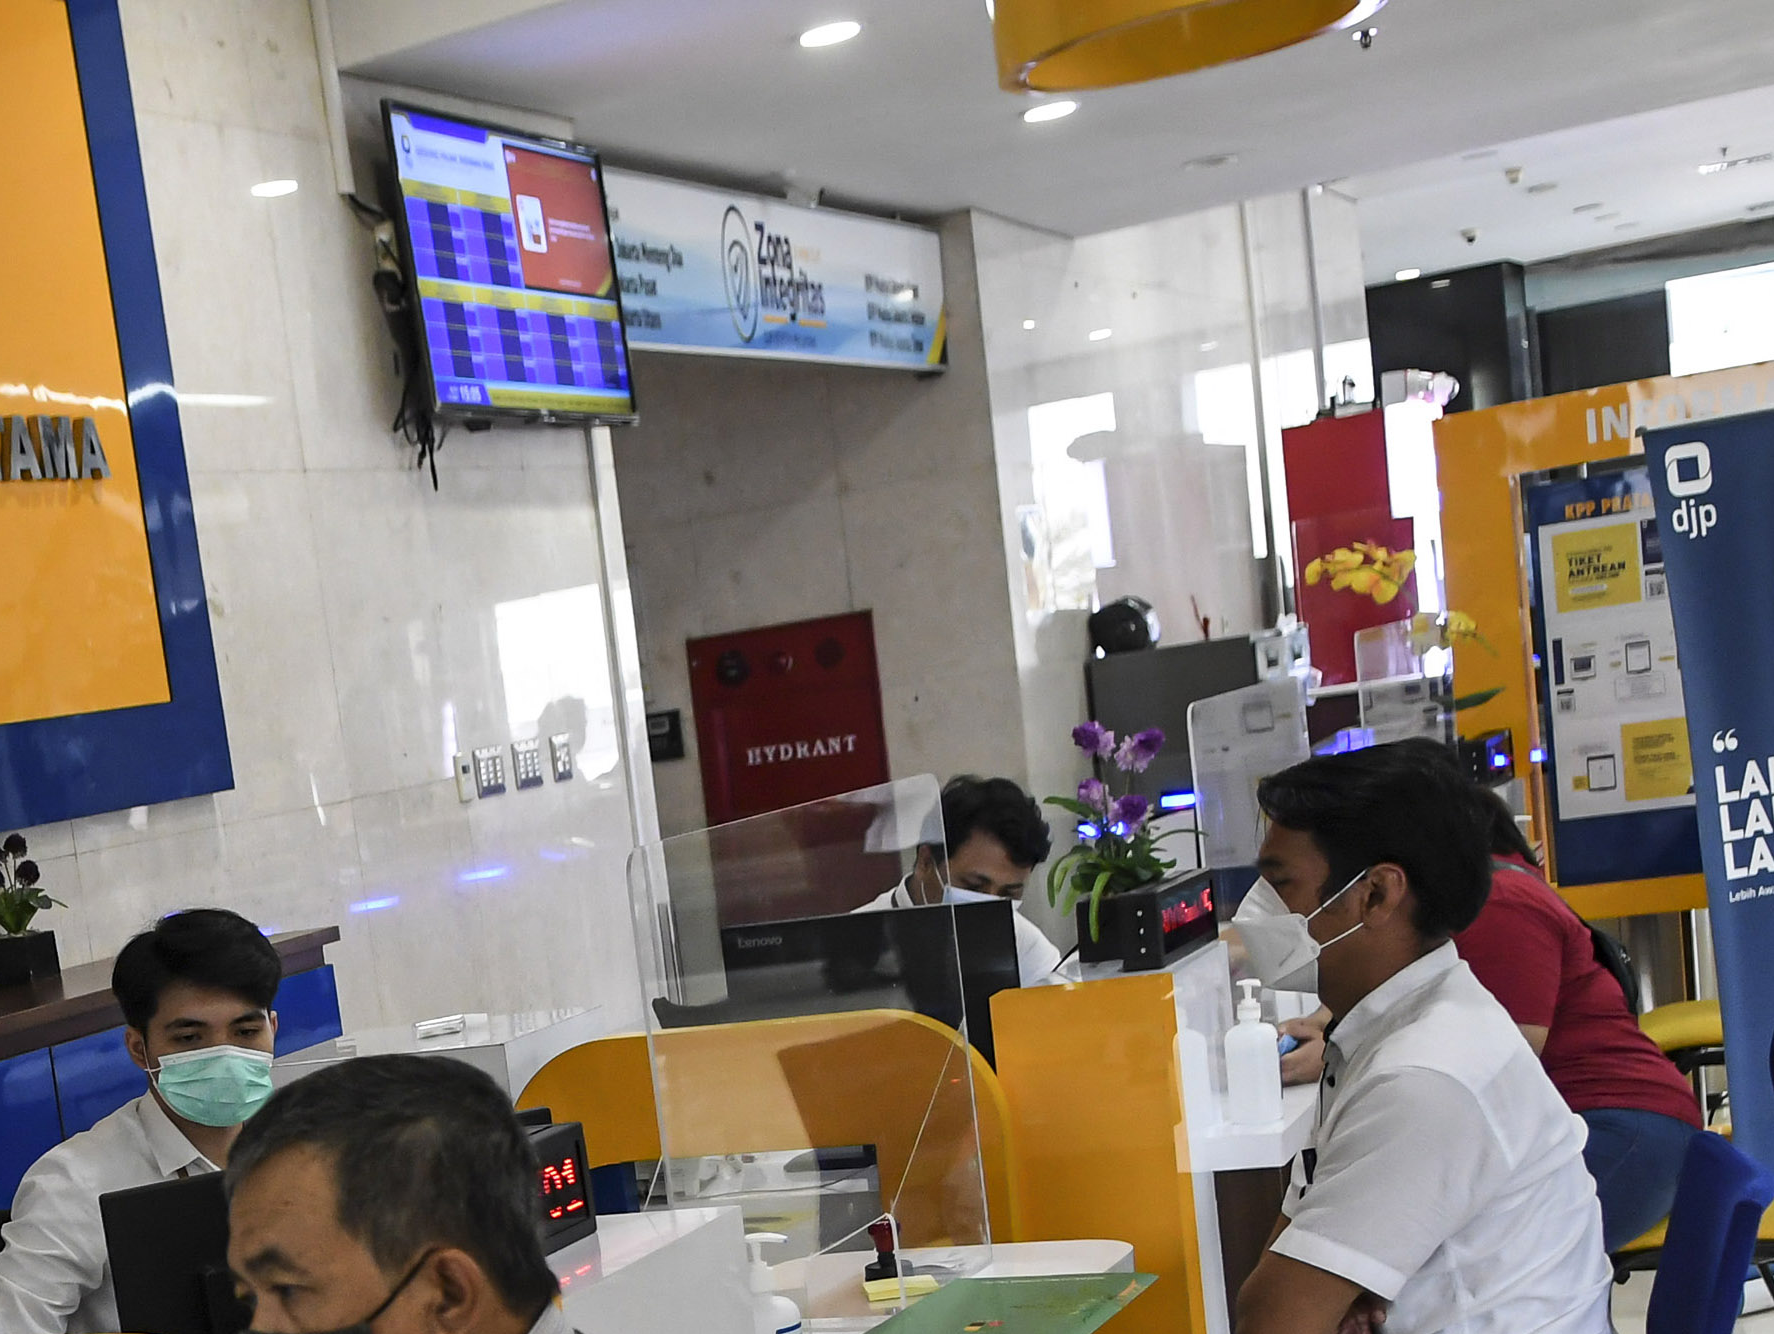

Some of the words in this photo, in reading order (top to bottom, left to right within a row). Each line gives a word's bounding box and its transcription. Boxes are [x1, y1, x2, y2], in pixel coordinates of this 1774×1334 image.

[753, 221, 794, 270] Zona
[1671, 498, 1718, 540] djp
[746, 734, 858, 767] HYDRANT
[1718, 795, 1774, 843] LA
[737, 935, 783, 949] Lenovo
